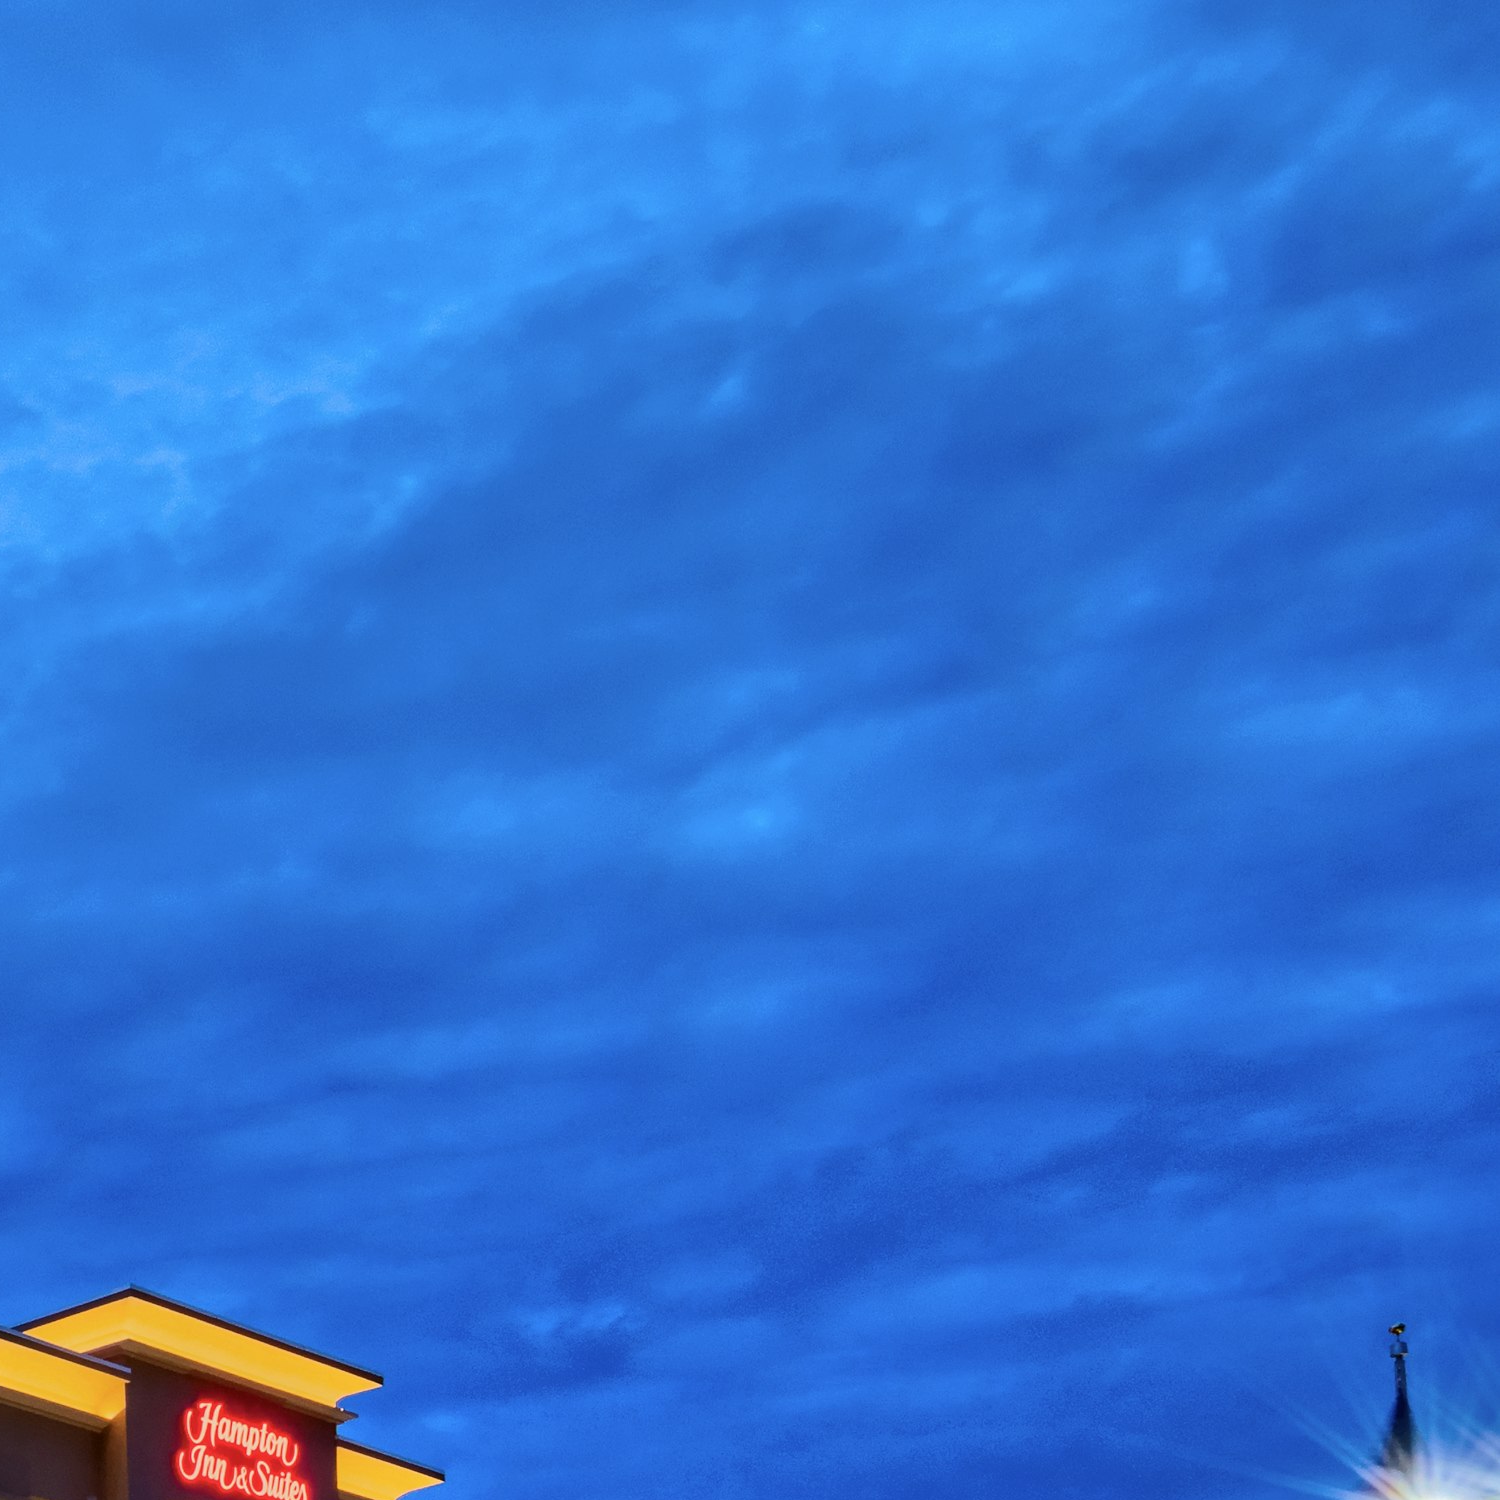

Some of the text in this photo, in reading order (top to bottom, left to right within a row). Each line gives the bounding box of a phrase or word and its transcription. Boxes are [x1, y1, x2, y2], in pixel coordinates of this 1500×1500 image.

[186, 1402, 298, 1466] Hampton
[178, 1445, 237, 1490] Inn
[236, 1466, 251, 1495] &
